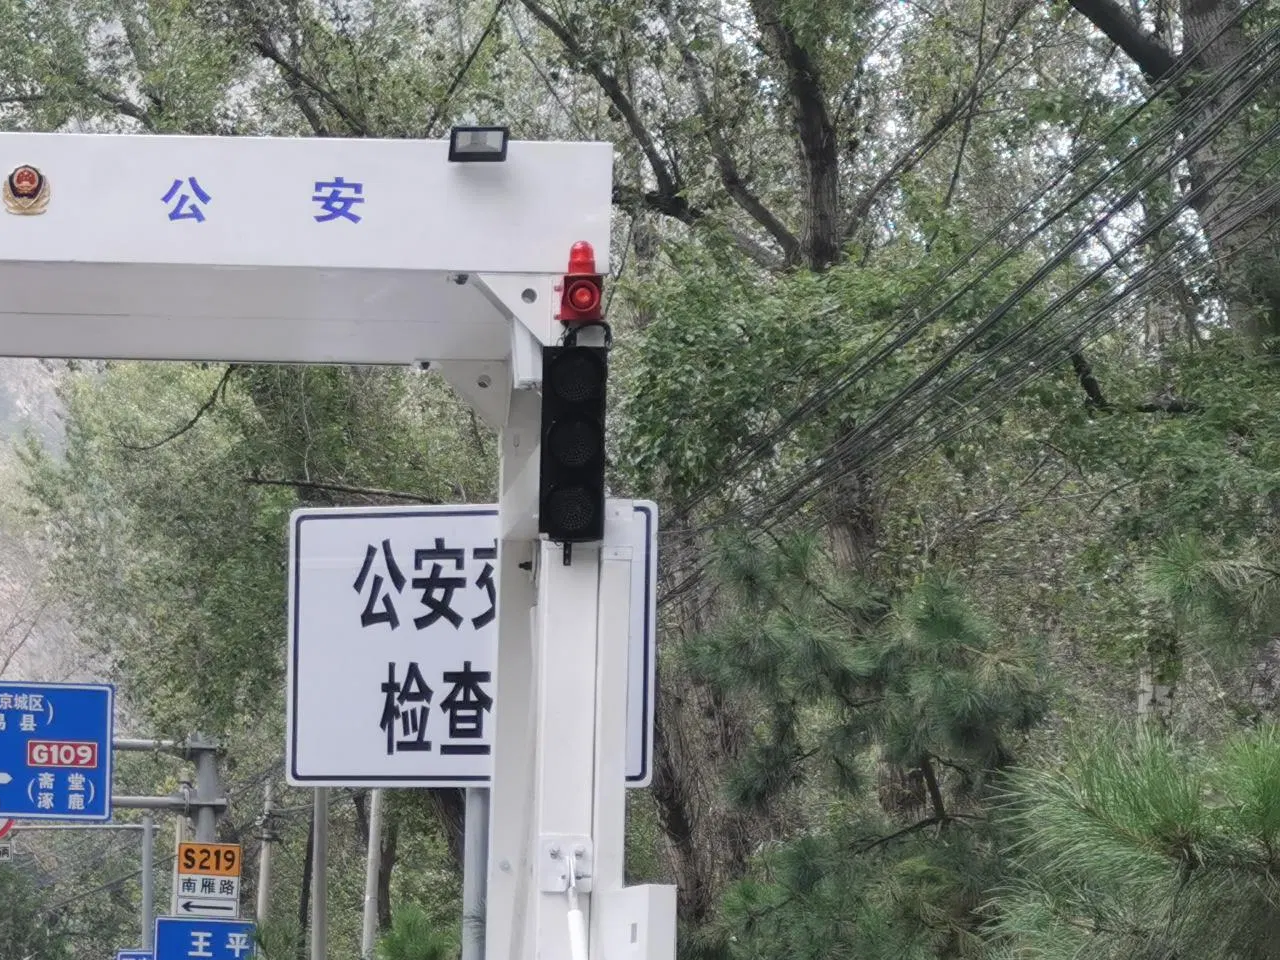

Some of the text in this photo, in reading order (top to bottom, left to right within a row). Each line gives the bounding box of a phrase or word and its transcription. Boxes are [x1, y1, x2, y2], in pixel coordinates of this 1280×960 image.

[380, 661, 493, 755] 检查
[32, 744, 93, 765] G109
[38, 772, 86, 790] 斋堂
[37, 792, 85, 810] 涿鹿
[183, 847, 236, 871] S219
[181, 877, 235, 895] 南雁路
[187, 931, 250, 958] 王平
